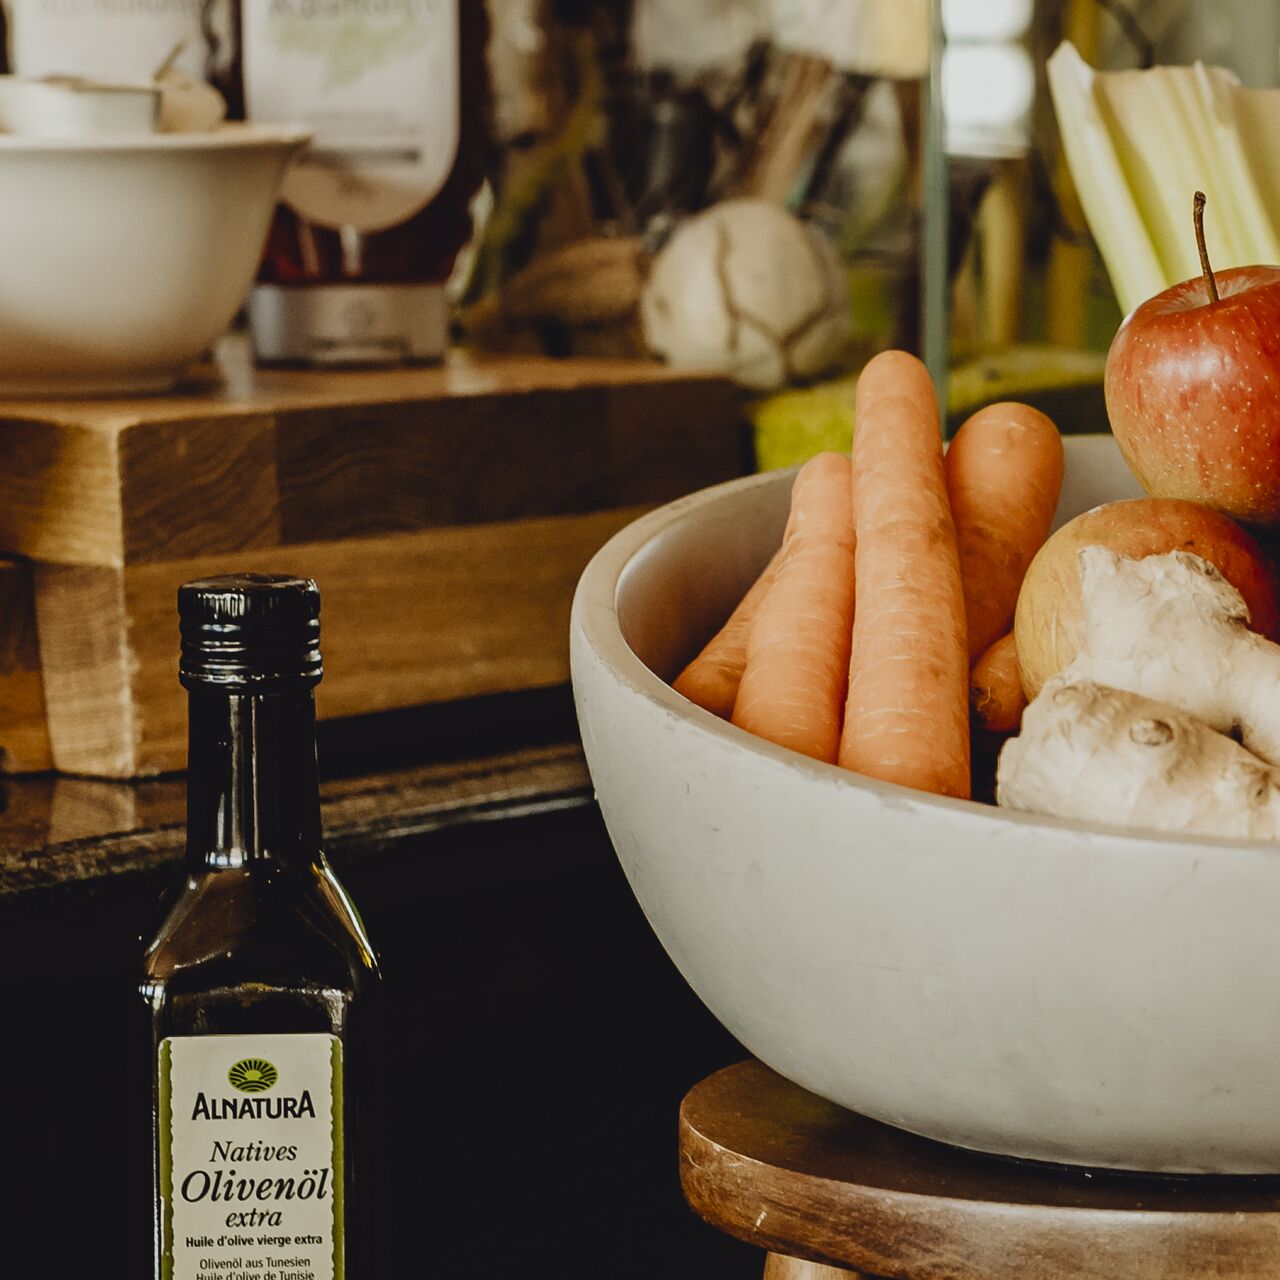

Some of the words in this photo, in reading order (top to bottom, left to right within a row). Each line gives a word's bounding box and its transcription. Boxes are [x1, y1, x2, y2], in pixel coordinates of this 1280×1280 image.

[191, 1090, 316, 1121] ALNATURA
[209, 1140, 298, 1163] Natives
[181, 1168, 329, 1203] Olivenöl
[225, 1207, 283, 1228] extra
[185, 1236, 214, 1248] Huile
[217, 1235, 254, 1247] d'olive
[257, 1234, 292, 1248] vierge
[294, 1234, 323, 1246] extra
[199, 1257, 243, 1270] Olivenöl
[245, 1260, 264, 1269] aus
[265, 1256, 311, 1268] Tunesien
